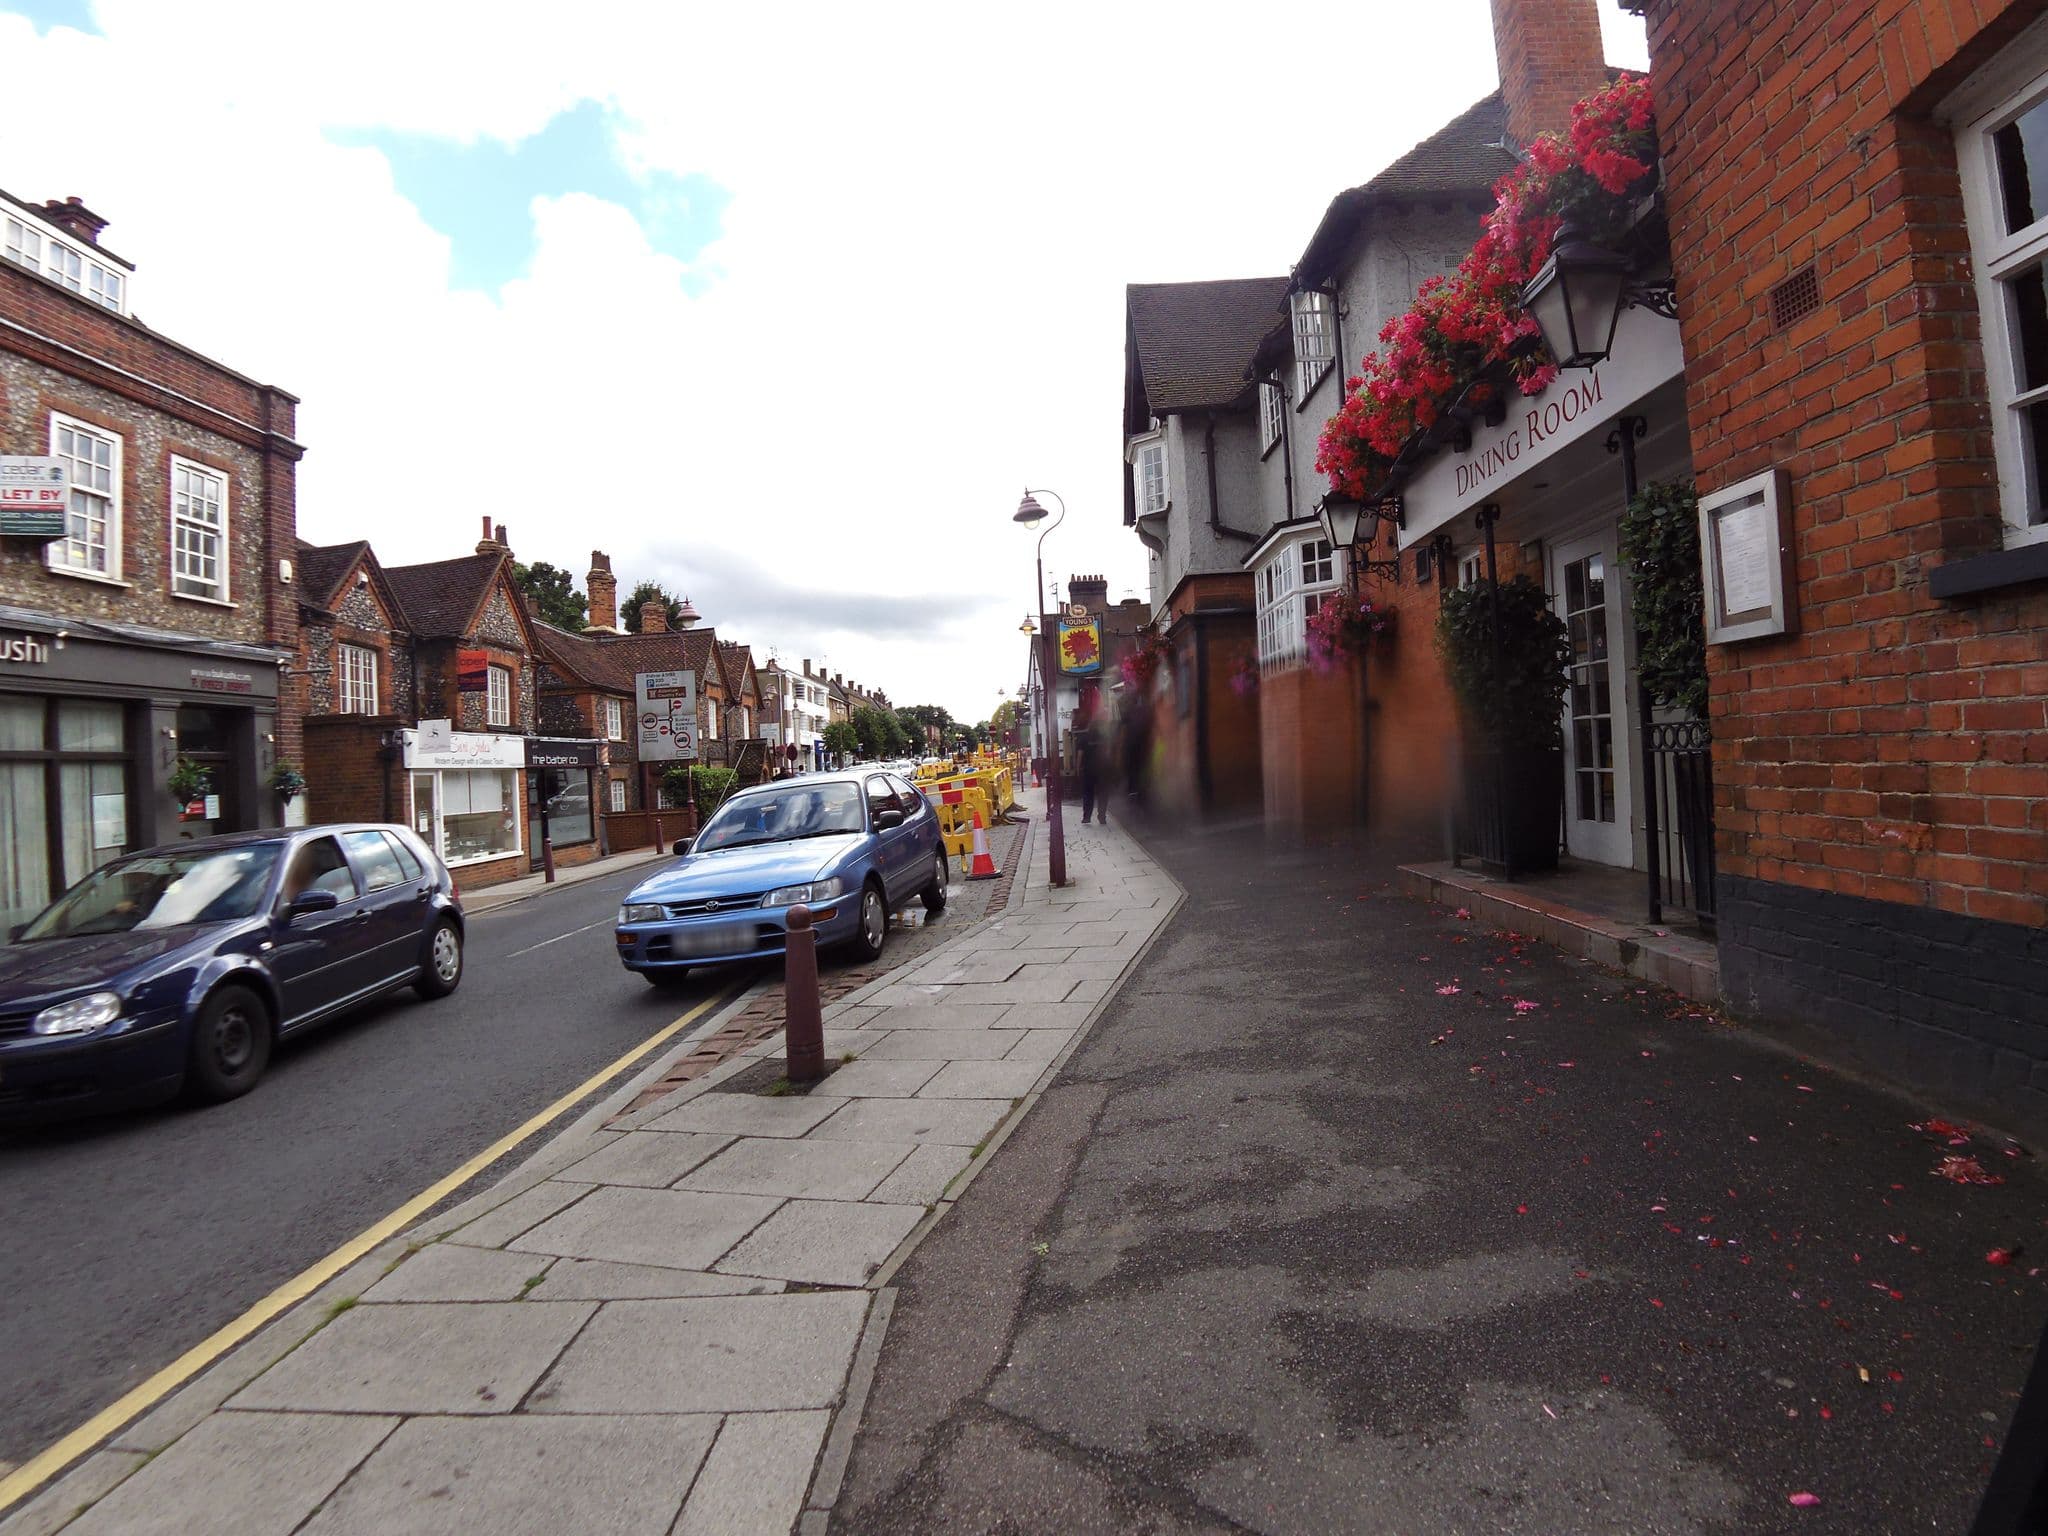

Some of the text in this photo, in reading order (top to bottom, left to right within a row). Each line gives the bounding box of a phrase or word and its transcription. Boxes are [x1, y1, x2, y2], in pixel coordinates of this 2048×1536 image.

[1456, 369, 1604, 498] DINING ROOM
[2, 489, 61, 500] LET BY
[532, 755, 579, 764] the barber co
